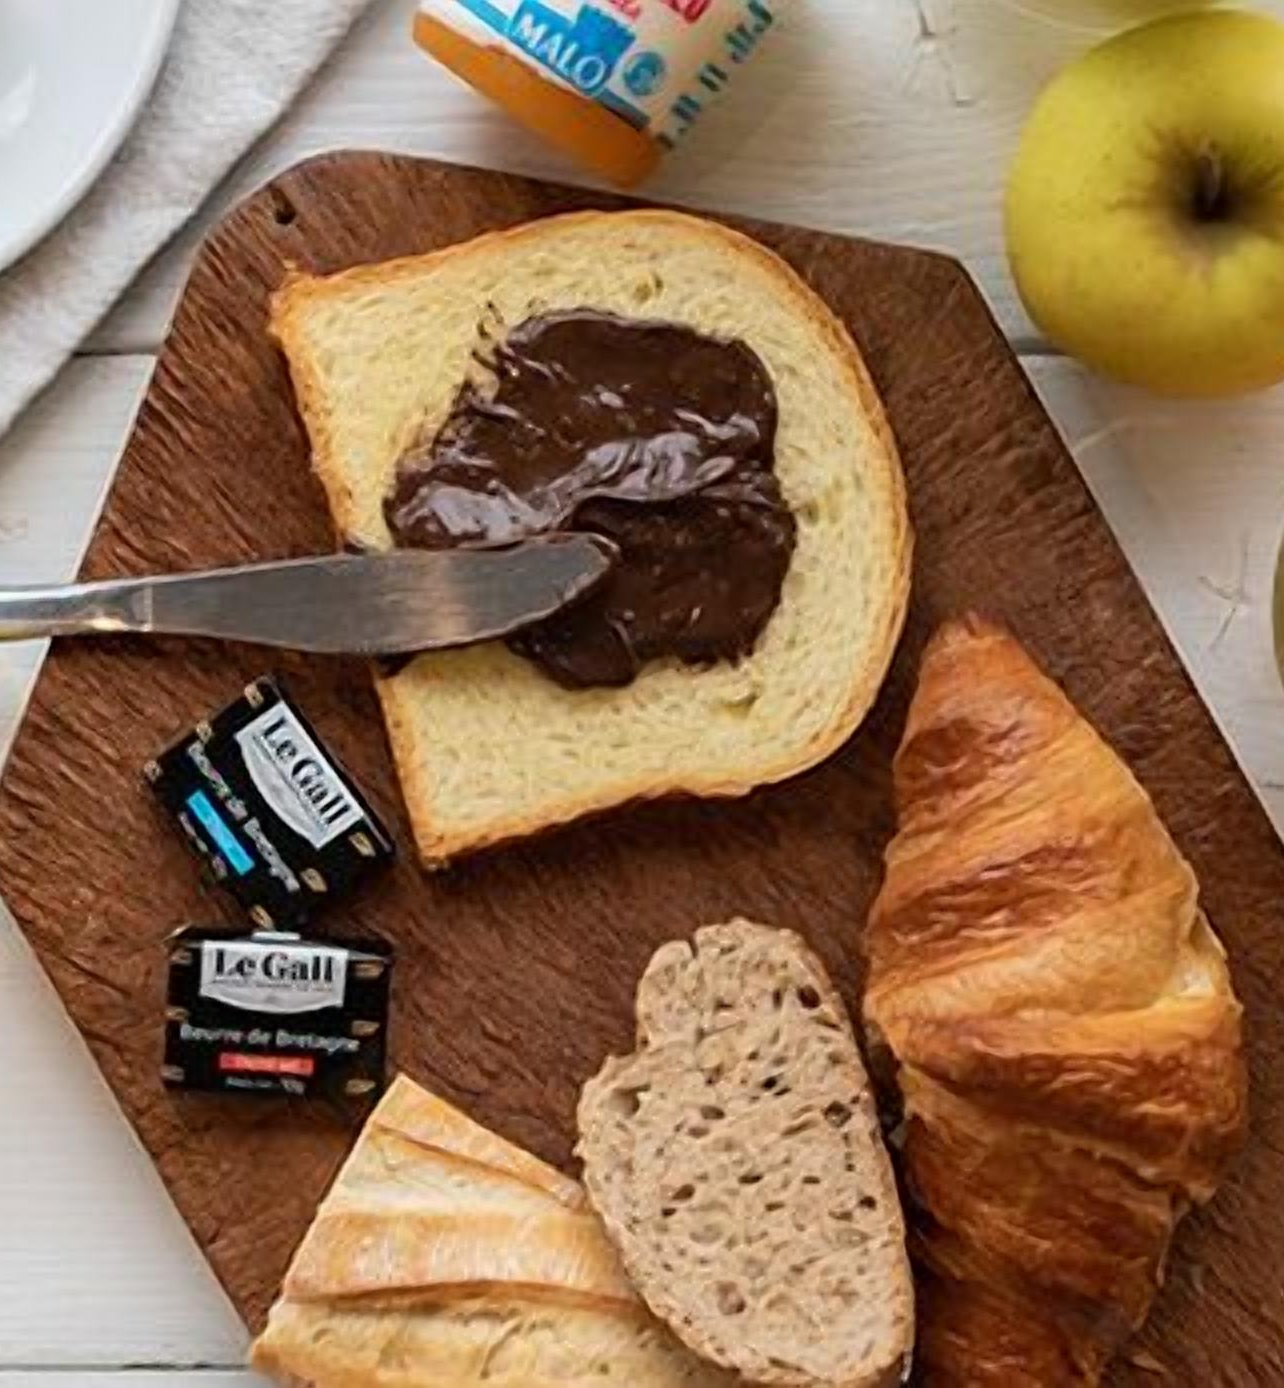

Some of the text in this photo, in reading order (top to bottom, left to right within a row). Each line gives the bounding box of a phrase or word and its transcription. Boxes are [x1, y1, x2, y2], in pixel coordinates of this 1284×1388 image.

[517, 12, 606, 90] MALO
[263, 716, 298, 762] Le
[291, 757, 351, 826] Gall
[214, 947, 333, 983] Le Gall
